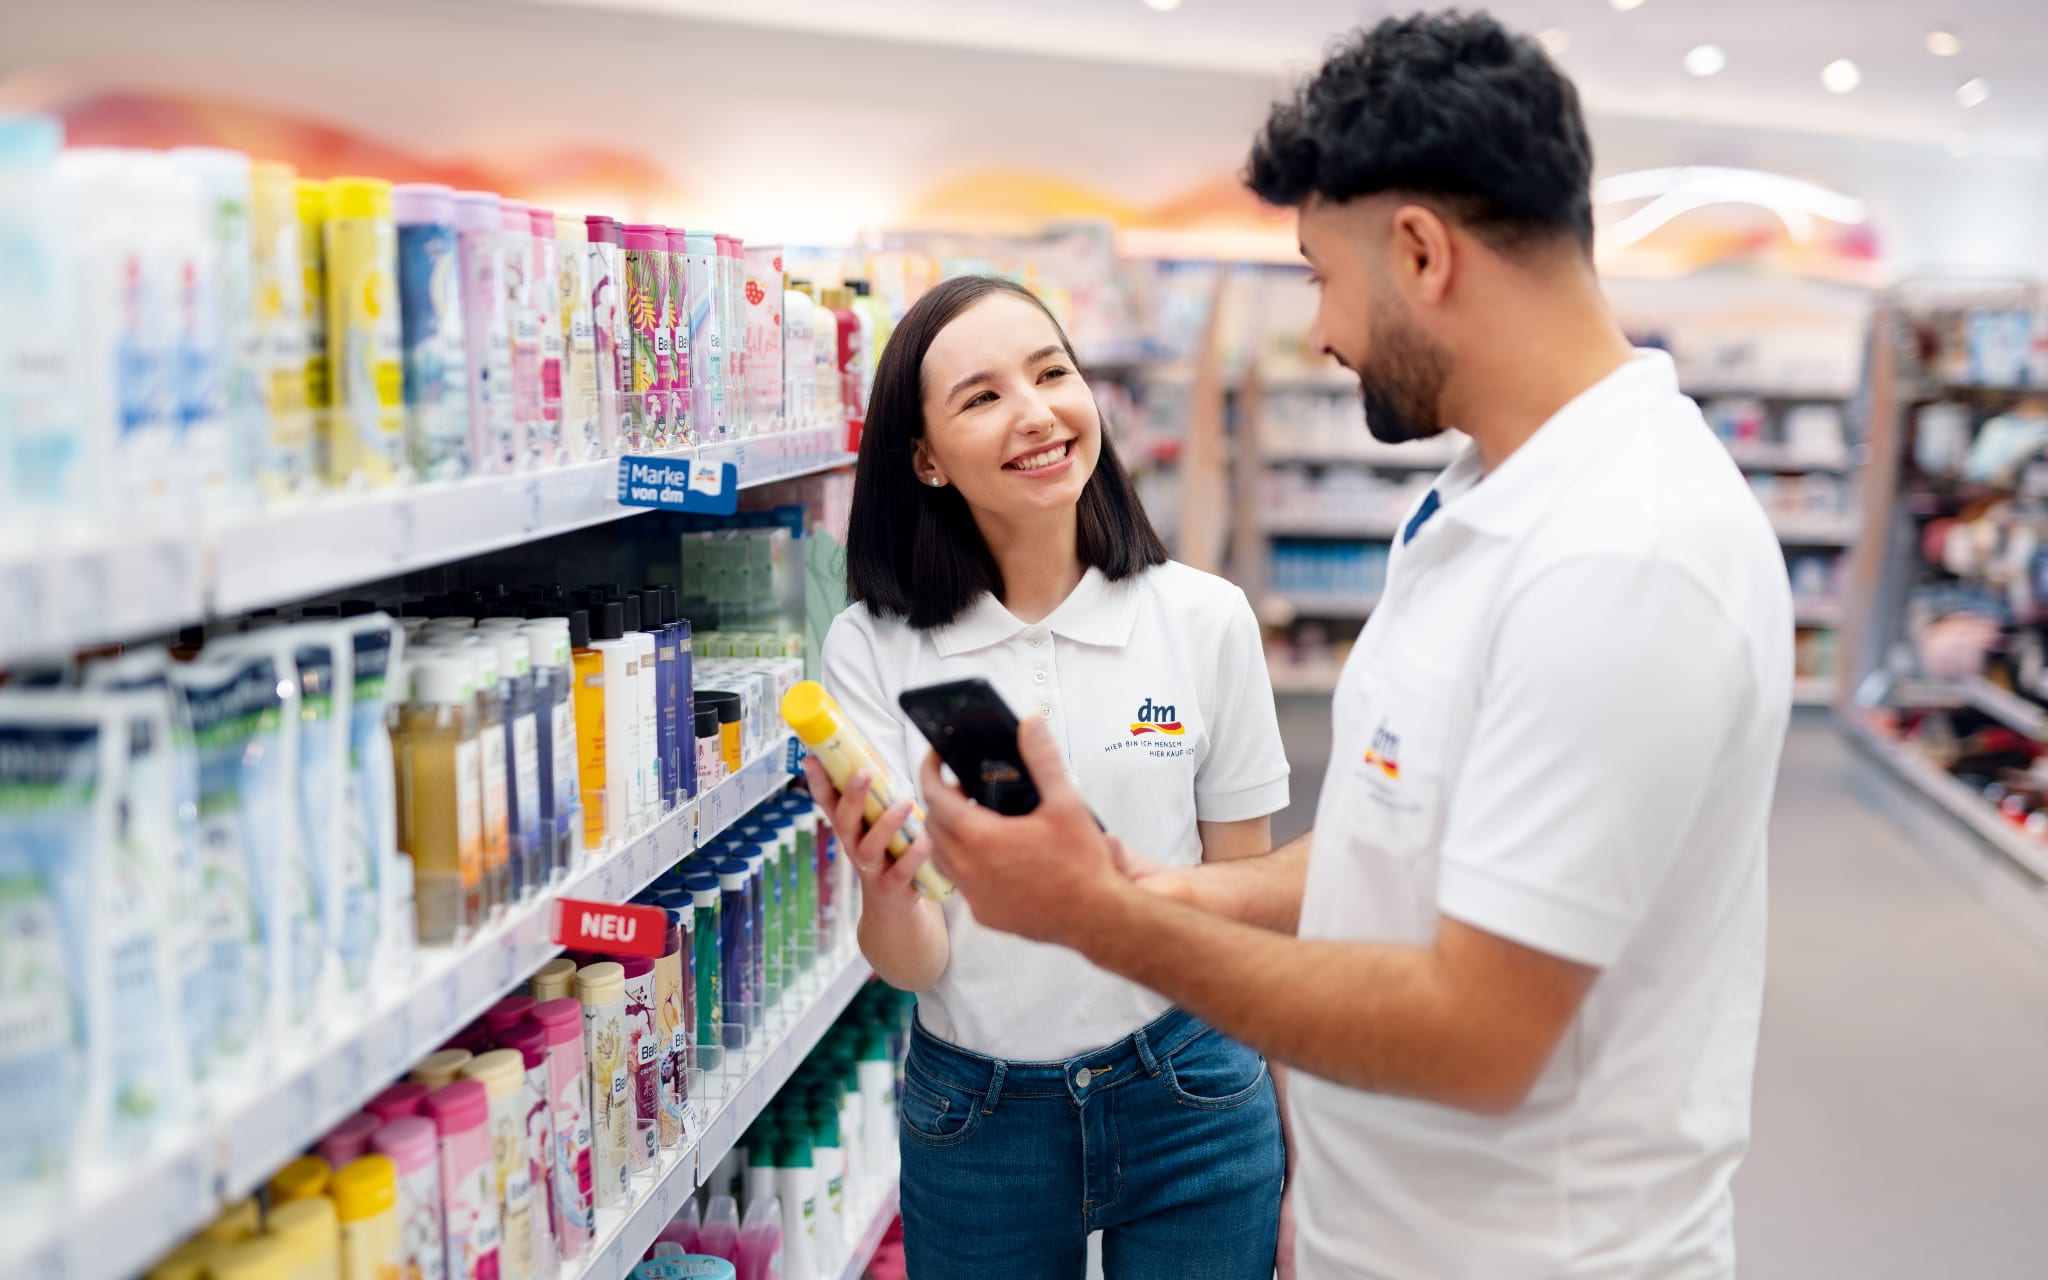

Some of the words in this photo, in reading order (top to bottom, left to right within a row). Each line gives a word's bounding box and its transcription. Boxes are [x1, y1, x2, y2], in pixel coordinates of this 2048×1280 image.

[631, 463, 686, 487] Marke
[631, 486, 658, 501] von
[660, 486, 684, 504] dm
[1137, 698, 1176, 723] dm
[1104, 742, 1123, 753] HIER
[1125, 740, 1138, 748] BIN
[1140, 740, 1152, 748] ICH
[1149, 750, 1165, 758] HIER
[1166, 749, 1184, 758] KAUF
[581, 911, 637, 943] NEU
